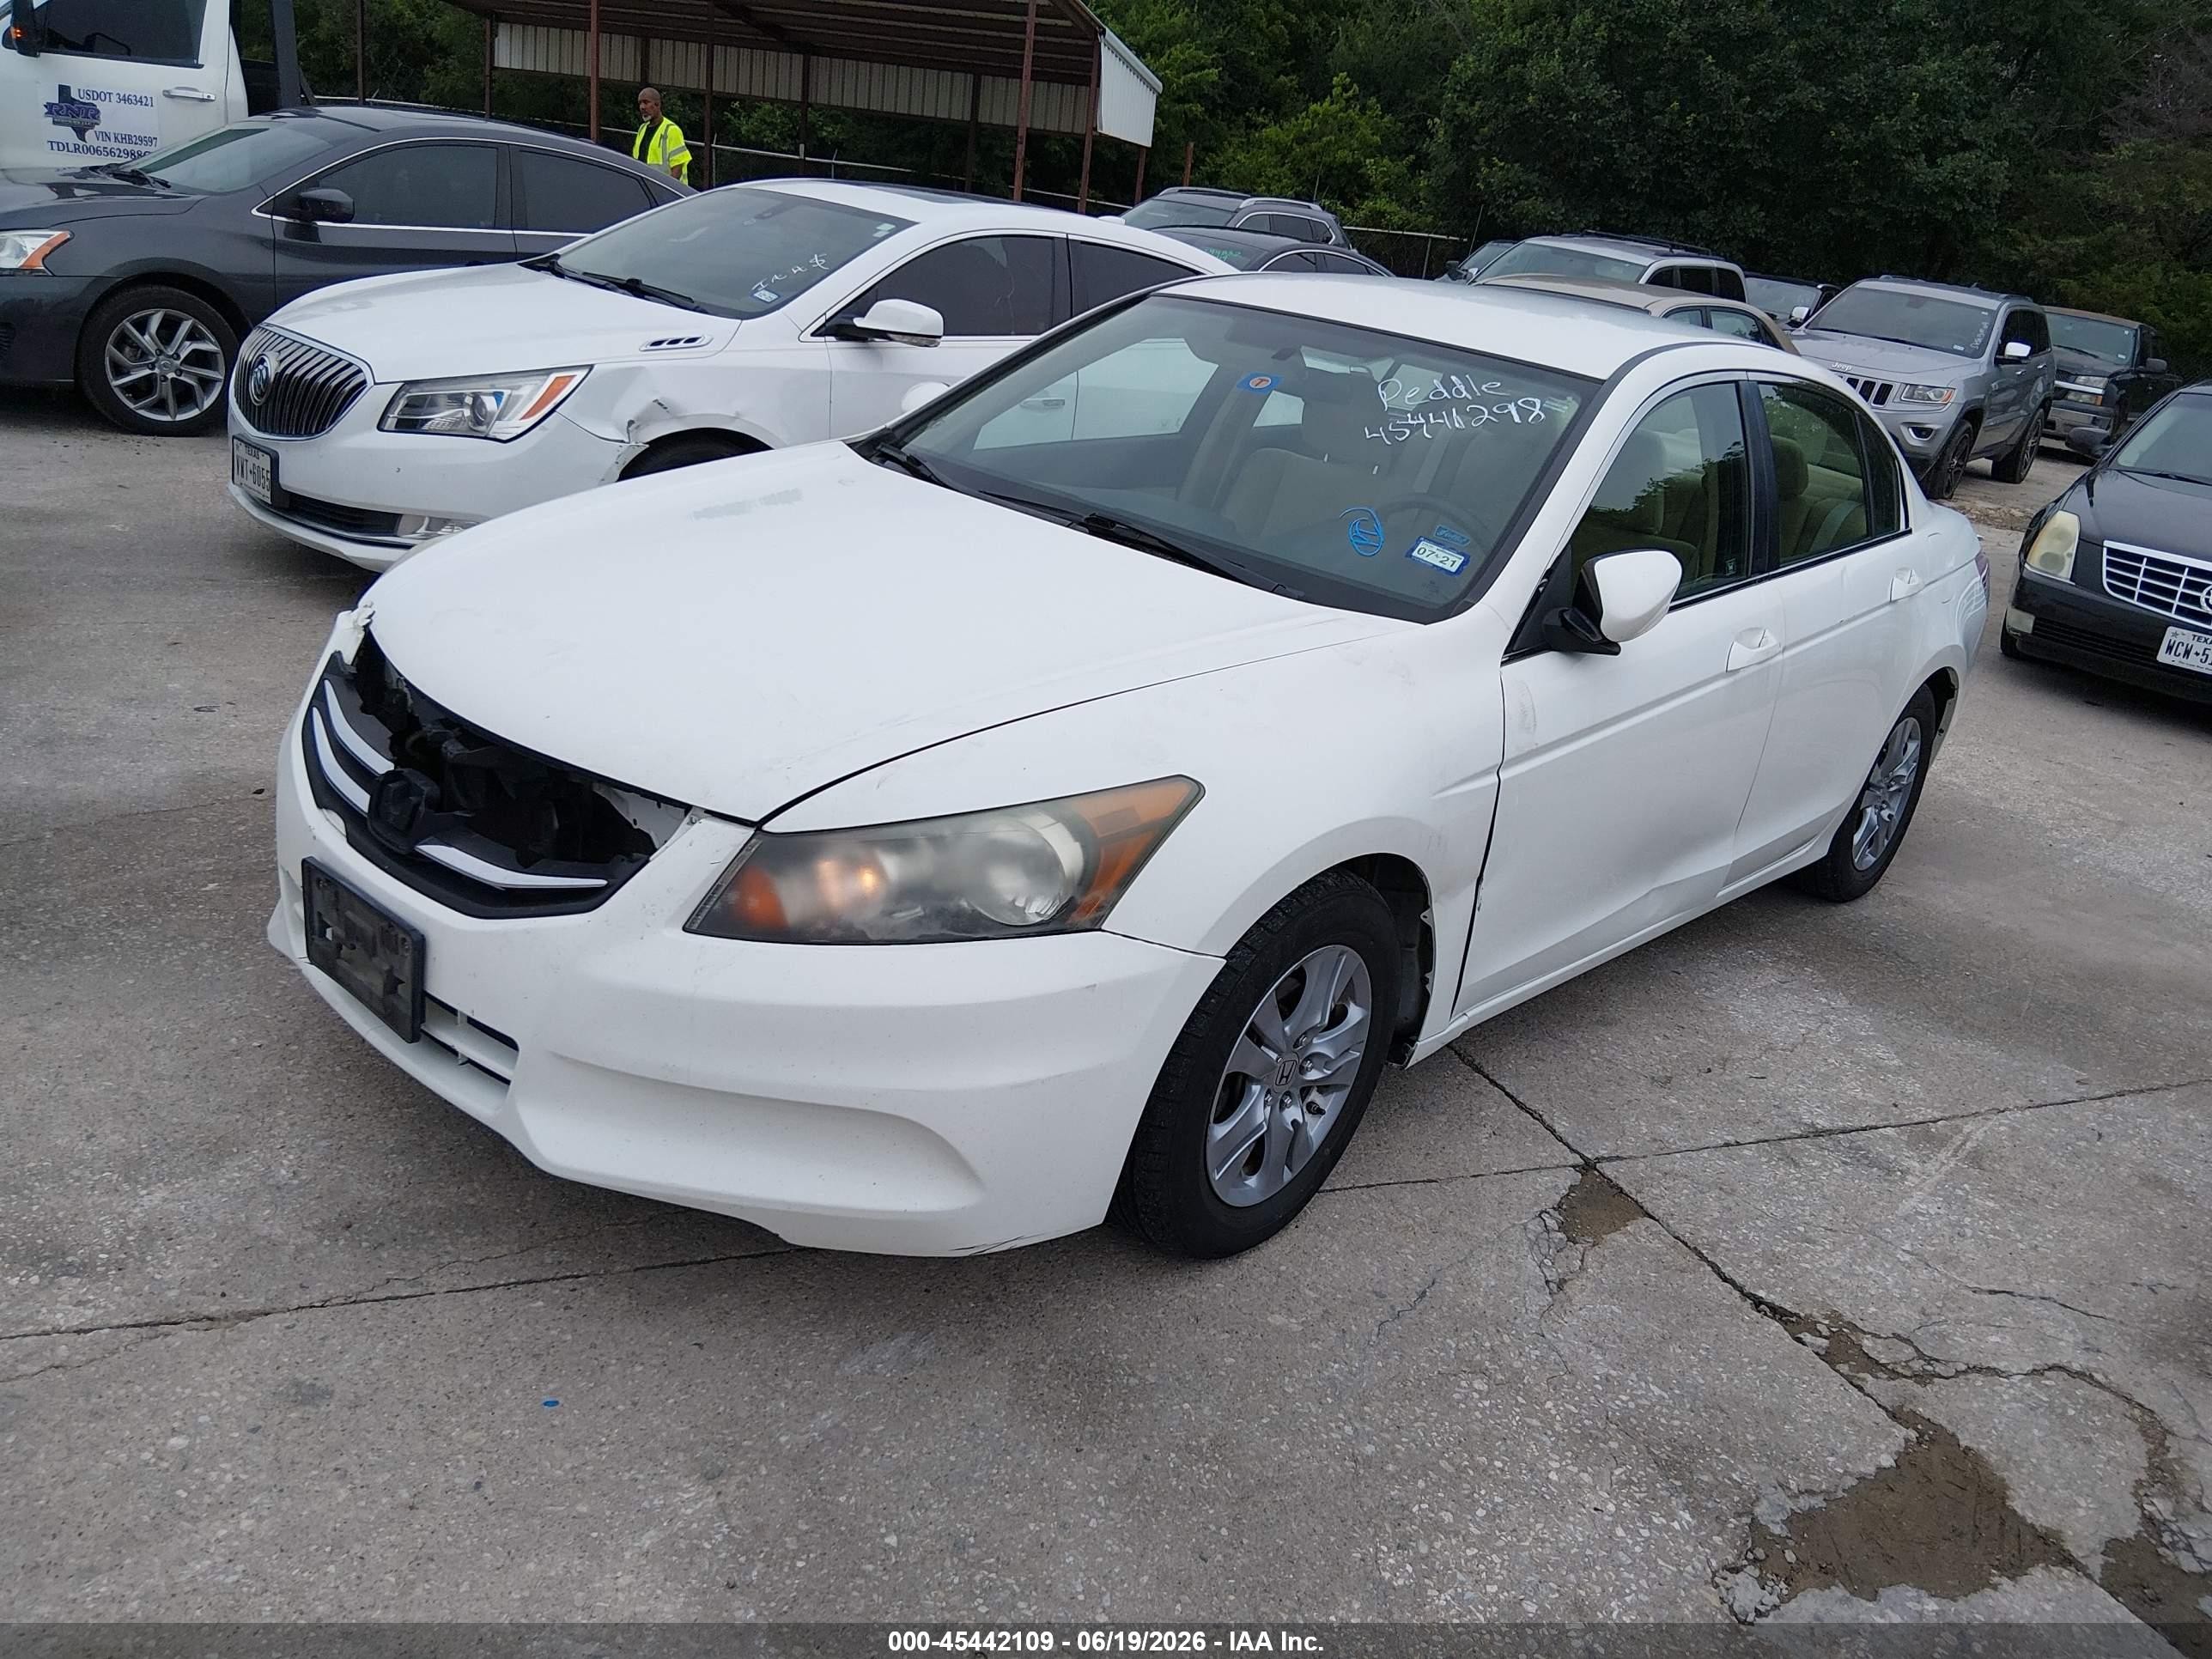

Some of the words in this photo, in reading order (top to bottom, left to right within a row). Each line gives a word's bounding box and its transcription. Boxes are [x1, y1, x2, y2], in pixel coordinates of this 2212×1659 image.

[77, 88, 113, 103] USDOT
[116, 92, 154, 107] 3463421
[94, 131, 112, 143] VIN
[113, 132, 158, 147] KHB29597
[1831, 362, 1852, 373] Jeep
[1378, 374, 1510, 412] Peddle
[245, 445, 260, 459] TEXAS
